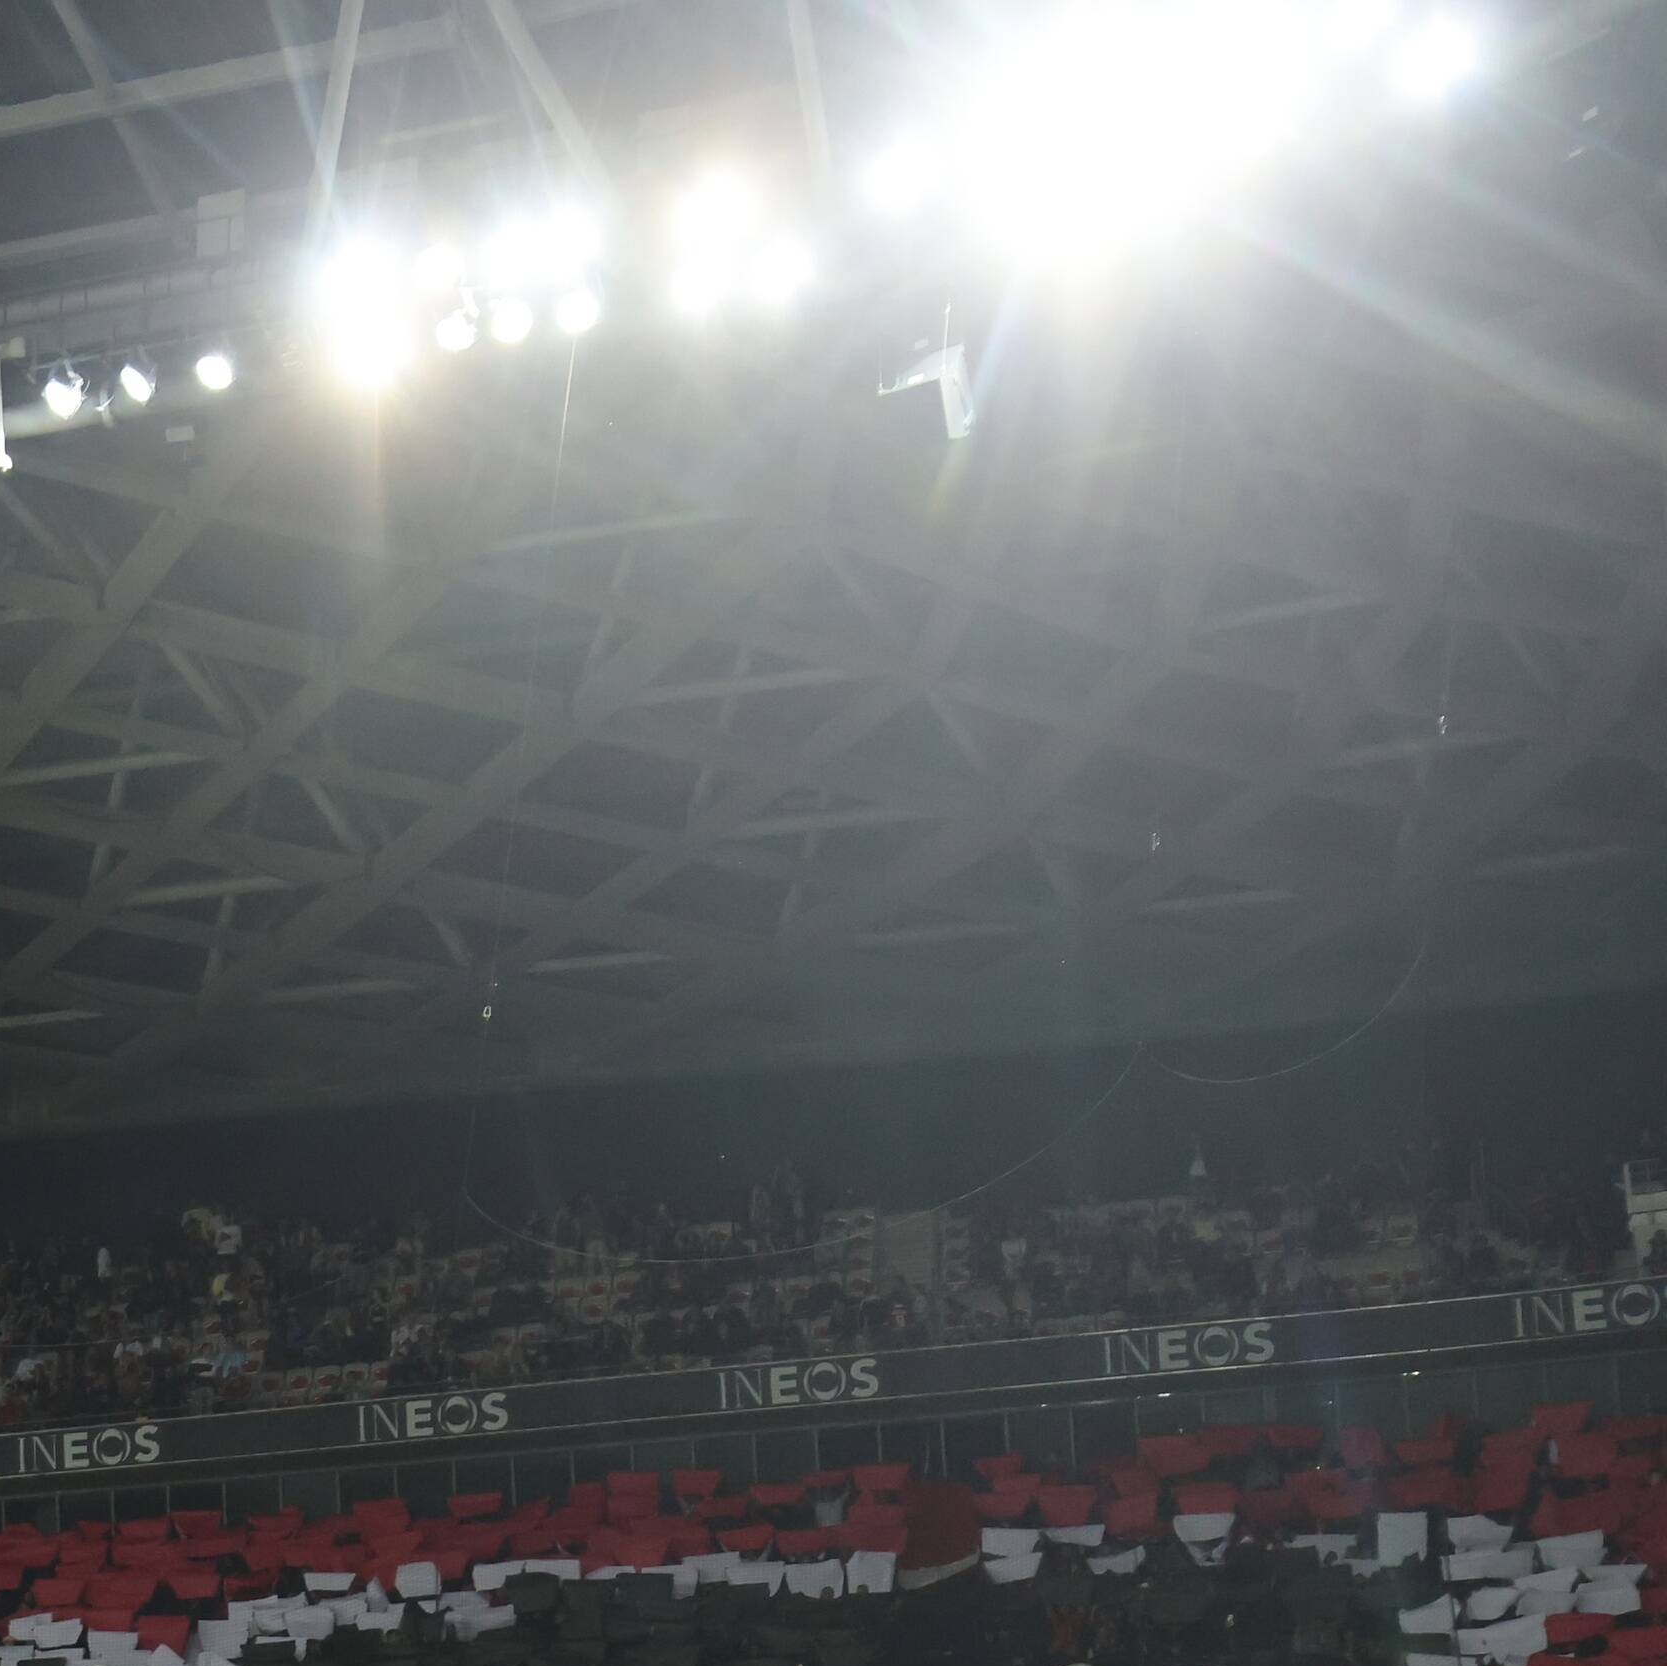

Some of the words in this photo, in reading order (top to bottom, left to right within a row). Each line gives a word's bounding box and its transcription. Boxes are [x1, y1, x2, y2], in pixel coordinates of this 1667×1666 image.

[1515, 1283, 1667, 1338] INEO
[1104, 1321, 1275, 1376] INEOS
[719, 1357, 880, 1410] INEOS
[358, 1392, 509, 1443] INEOS
[19, 1425, 160, 1474] INEOS
